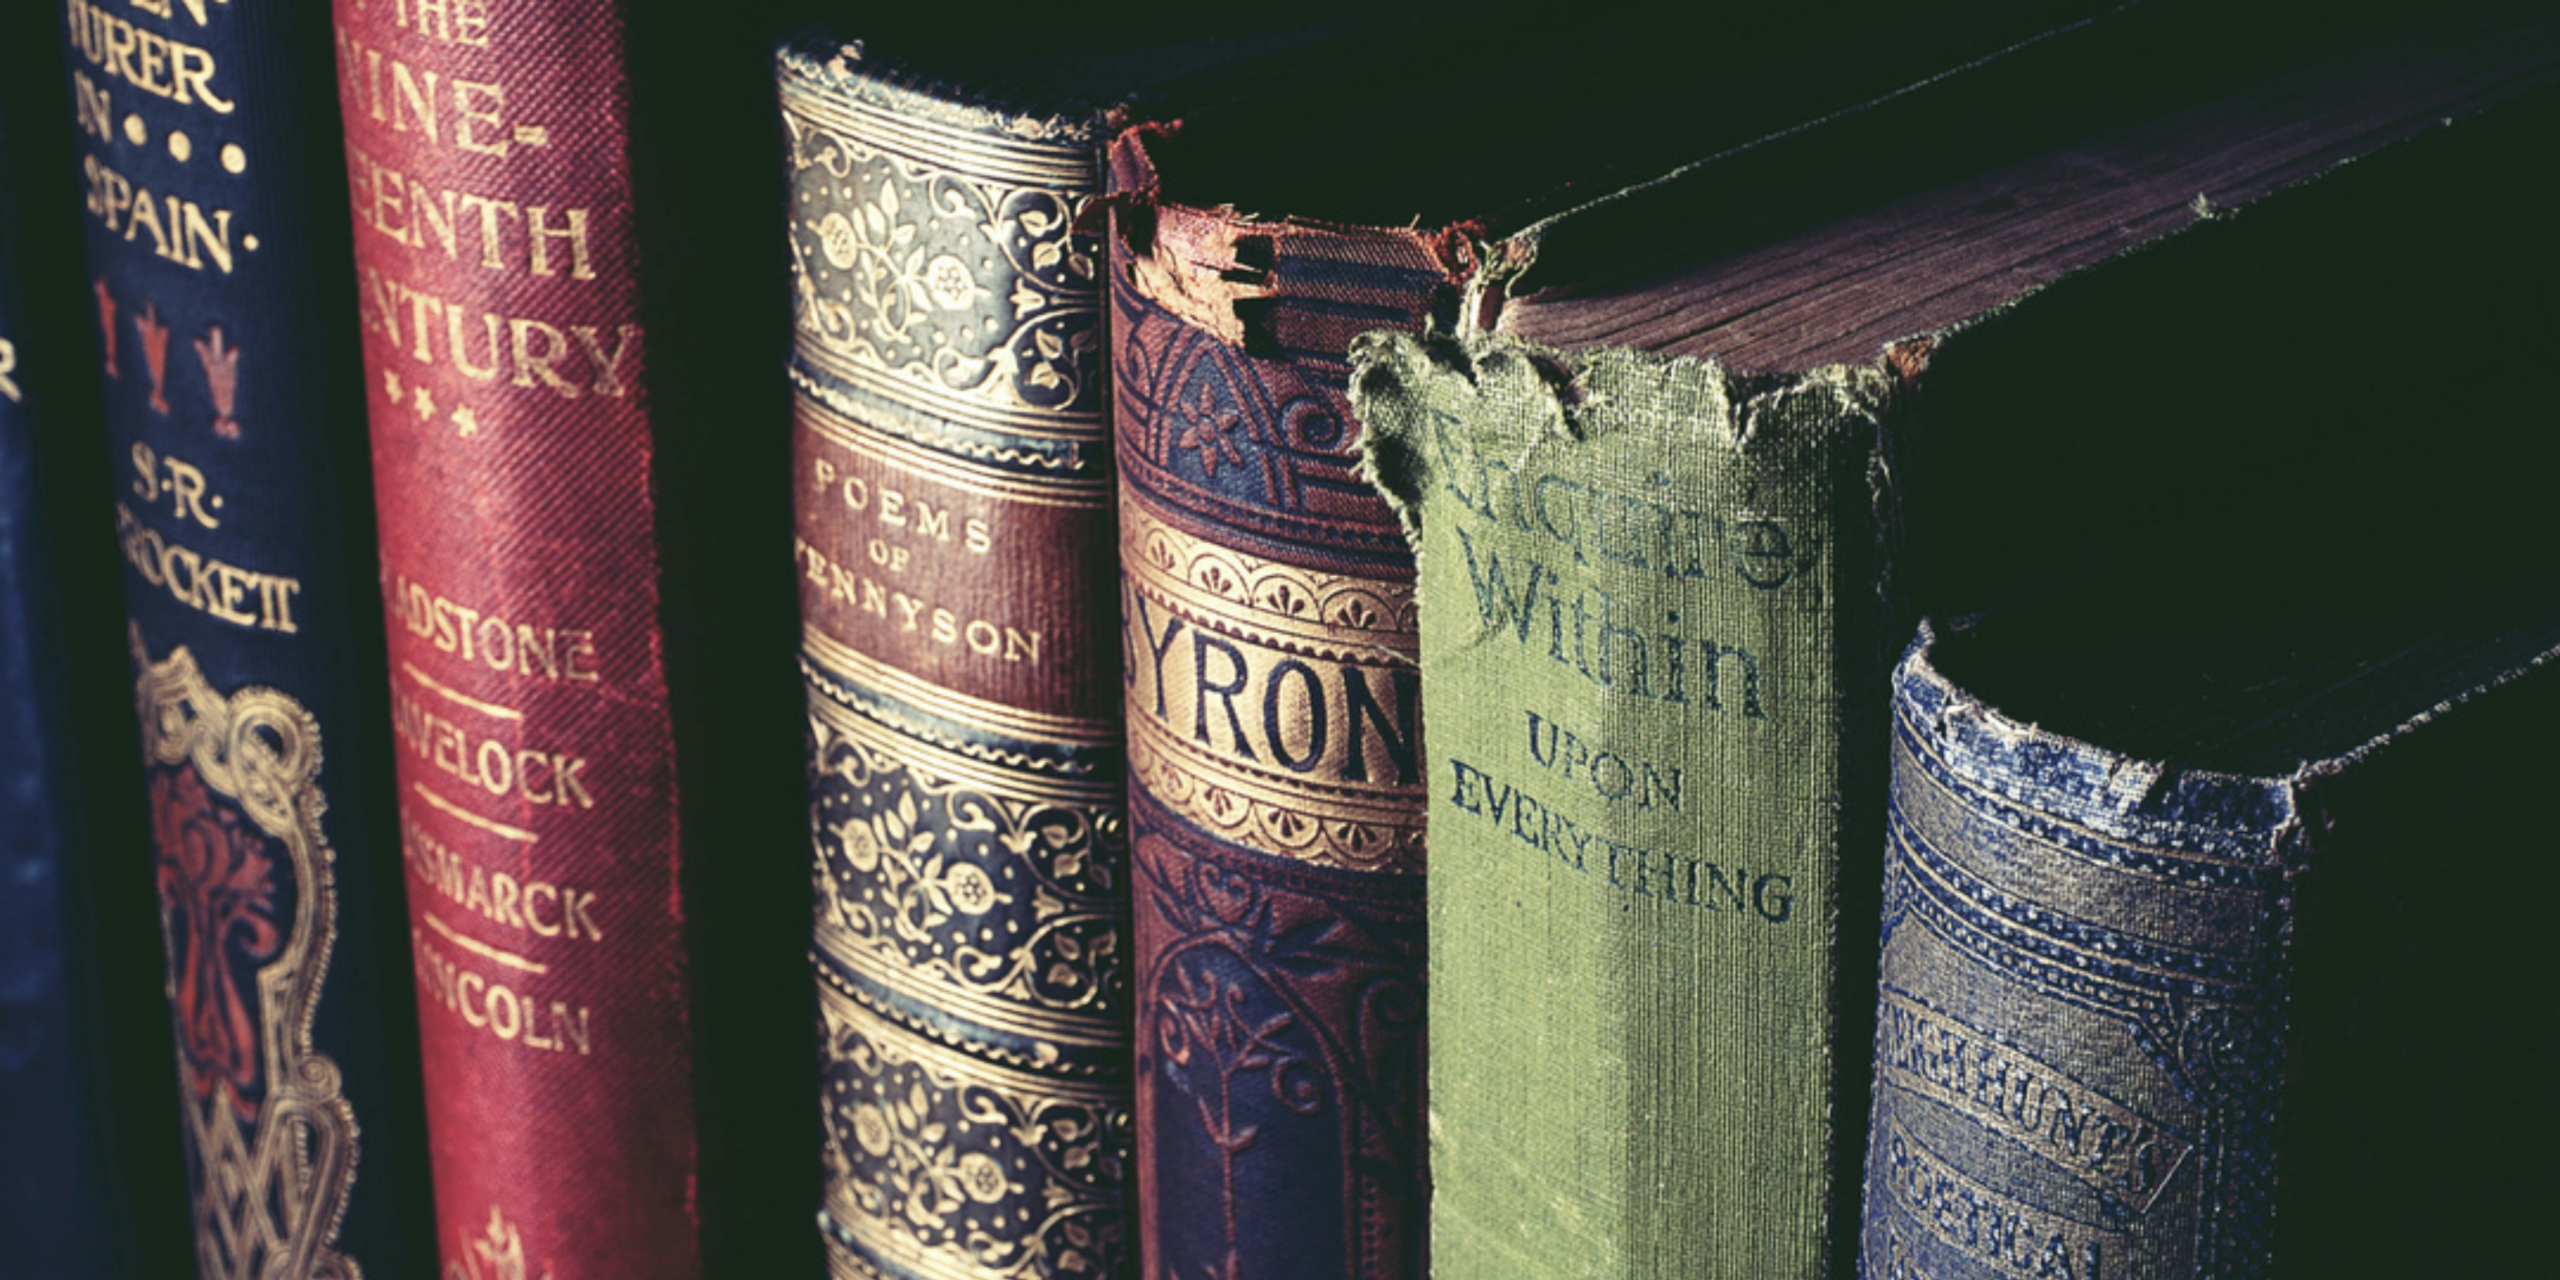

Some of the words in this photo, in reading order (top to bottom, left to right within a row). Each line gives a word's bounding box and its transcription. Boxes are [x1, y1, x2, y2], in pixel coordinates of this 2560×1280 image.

[814, 457, 991, 554] POEMS
[868, 538, 911, 572] OF
[1455, 522, 1768, 721] Within
[1524, 709, 1684, 814] UPON
[1448, 758, 1795, 924] EVERYTHING
